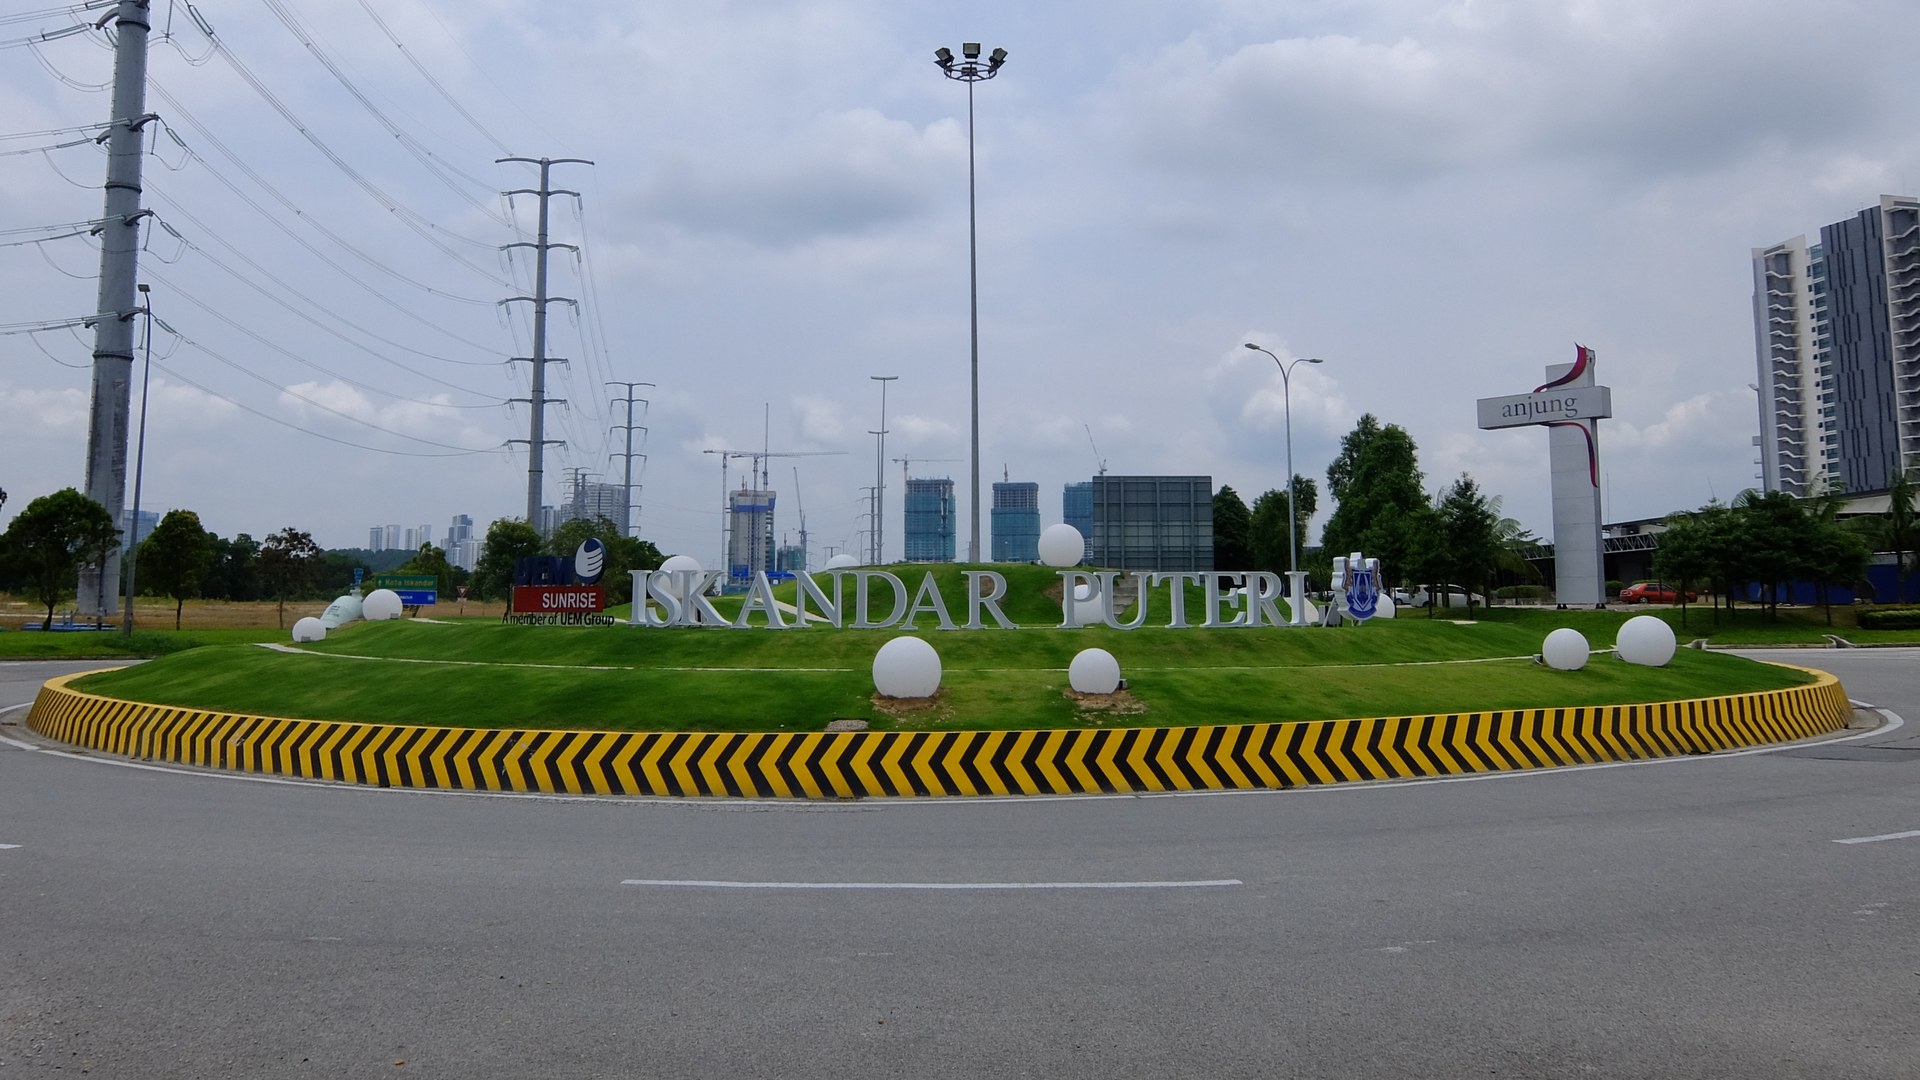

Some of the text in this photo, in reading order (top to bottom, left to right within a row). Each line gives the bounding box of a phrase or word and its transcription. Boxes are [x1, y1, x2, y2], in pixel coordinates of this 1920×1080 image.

[1502, 396, 1578, 420] anjung
[385, 578, 402, 586] Kota
[542, 592, 596, 608] SUNRISE
[626, 569, 1312, 630] ISKANDAR PUTERI
[502, 612, 615, 627] A member of UEM Group
